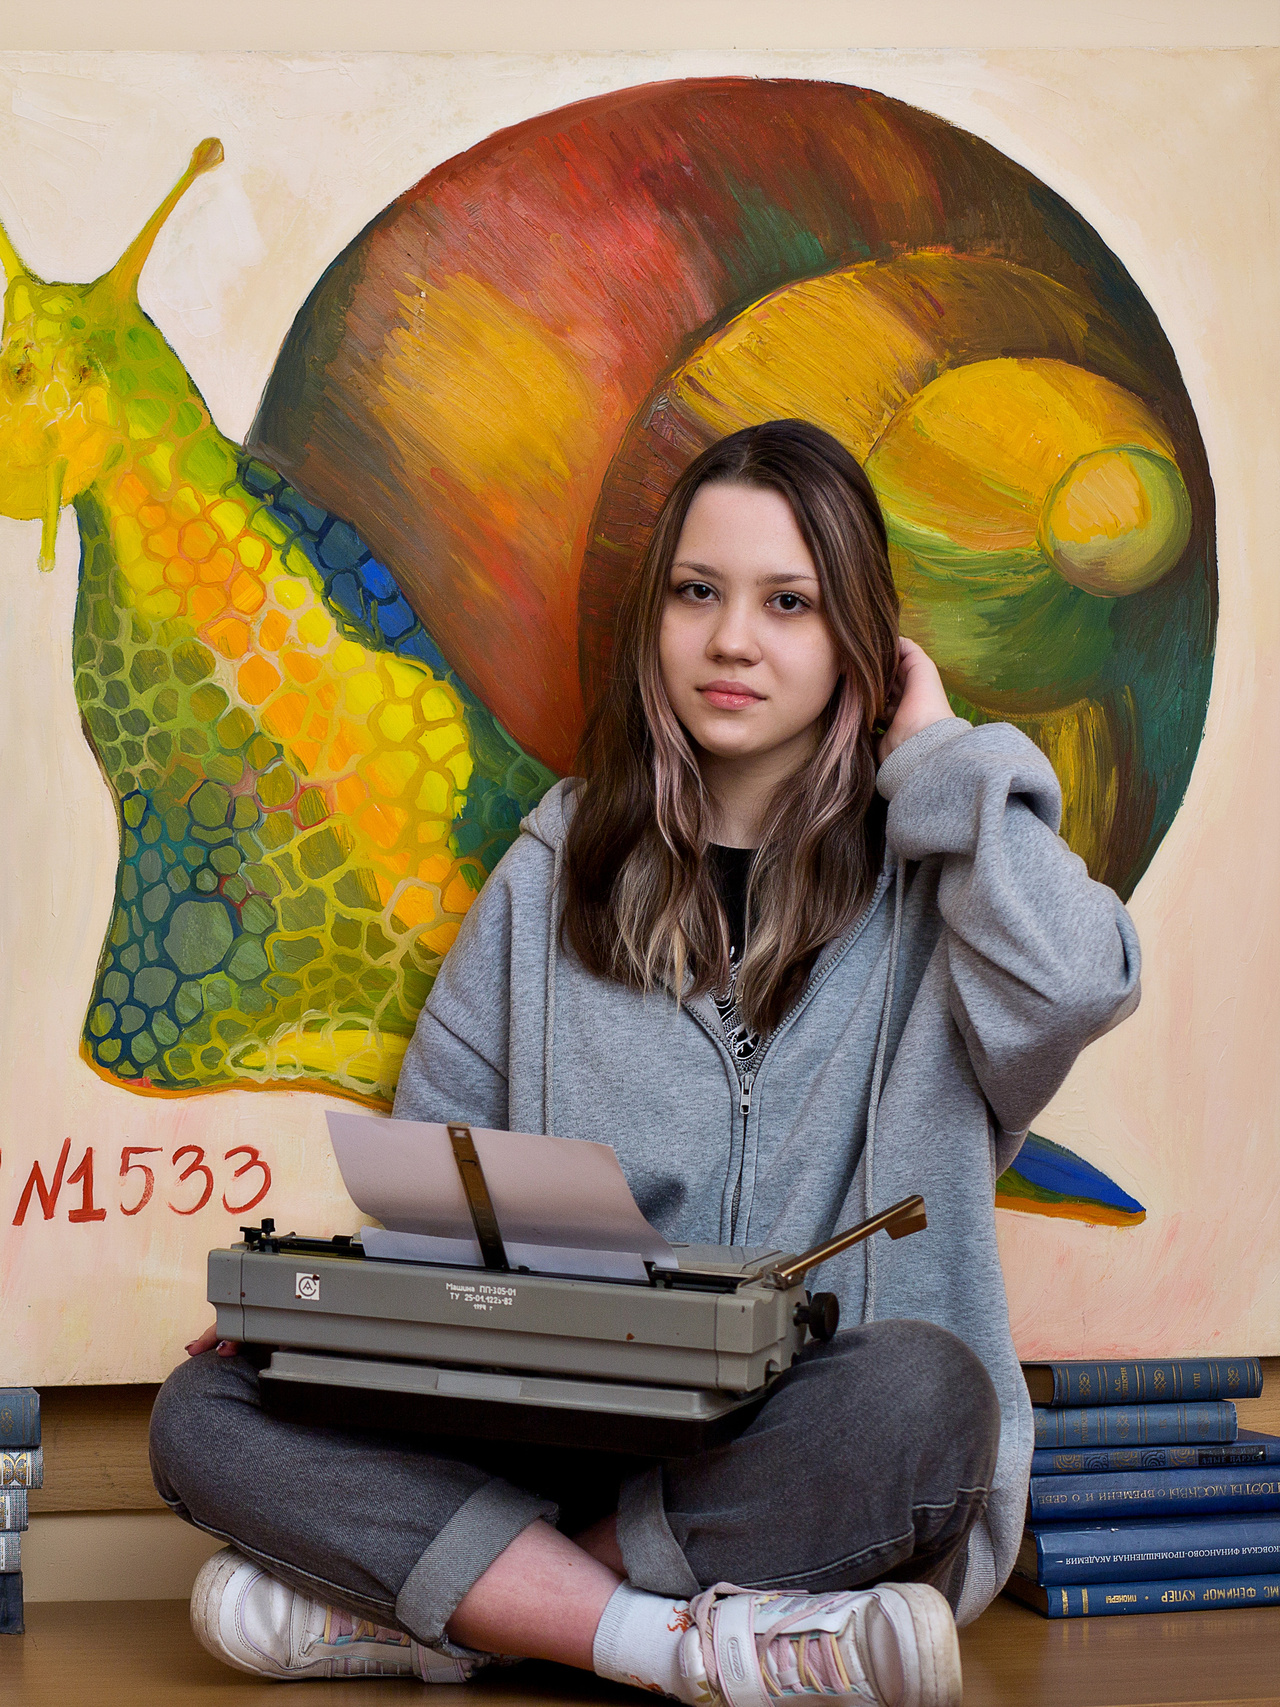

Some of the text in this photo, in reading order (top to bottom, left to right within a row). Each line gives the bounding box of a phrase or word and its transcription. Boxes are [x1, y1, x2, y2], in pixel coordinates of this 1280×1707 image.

[445, 1282, 517, 1297] Машина ПП-305-01
[450, 1292, 460, 1300] ТУ
[1193, 1372, 1201, 1389] VIII
[1072, 1494, 1080, 1502] О
[1086, 1494, 1094, 1502] И
[1098, 1490, 1155, 1501] ВРЕМЕНИ
[1170, 1485, 1228, 1500] МОСКВЫ
[1038, 1494, 1068, 1505] СЕБЕ
[1065, 1545, 1280, 1566] КОВСКАЯ ФИНАНСОВО-ПРОМЫШЛЕННАЯ АКАДЕМИЯ
[1106, 1594, 1137, 1604] ПИОНЕРЫ
[1161, 1589, 1196, 1602] КУПЕР
[1203, 1587, 1257, 1601] ФЕНИМОР
